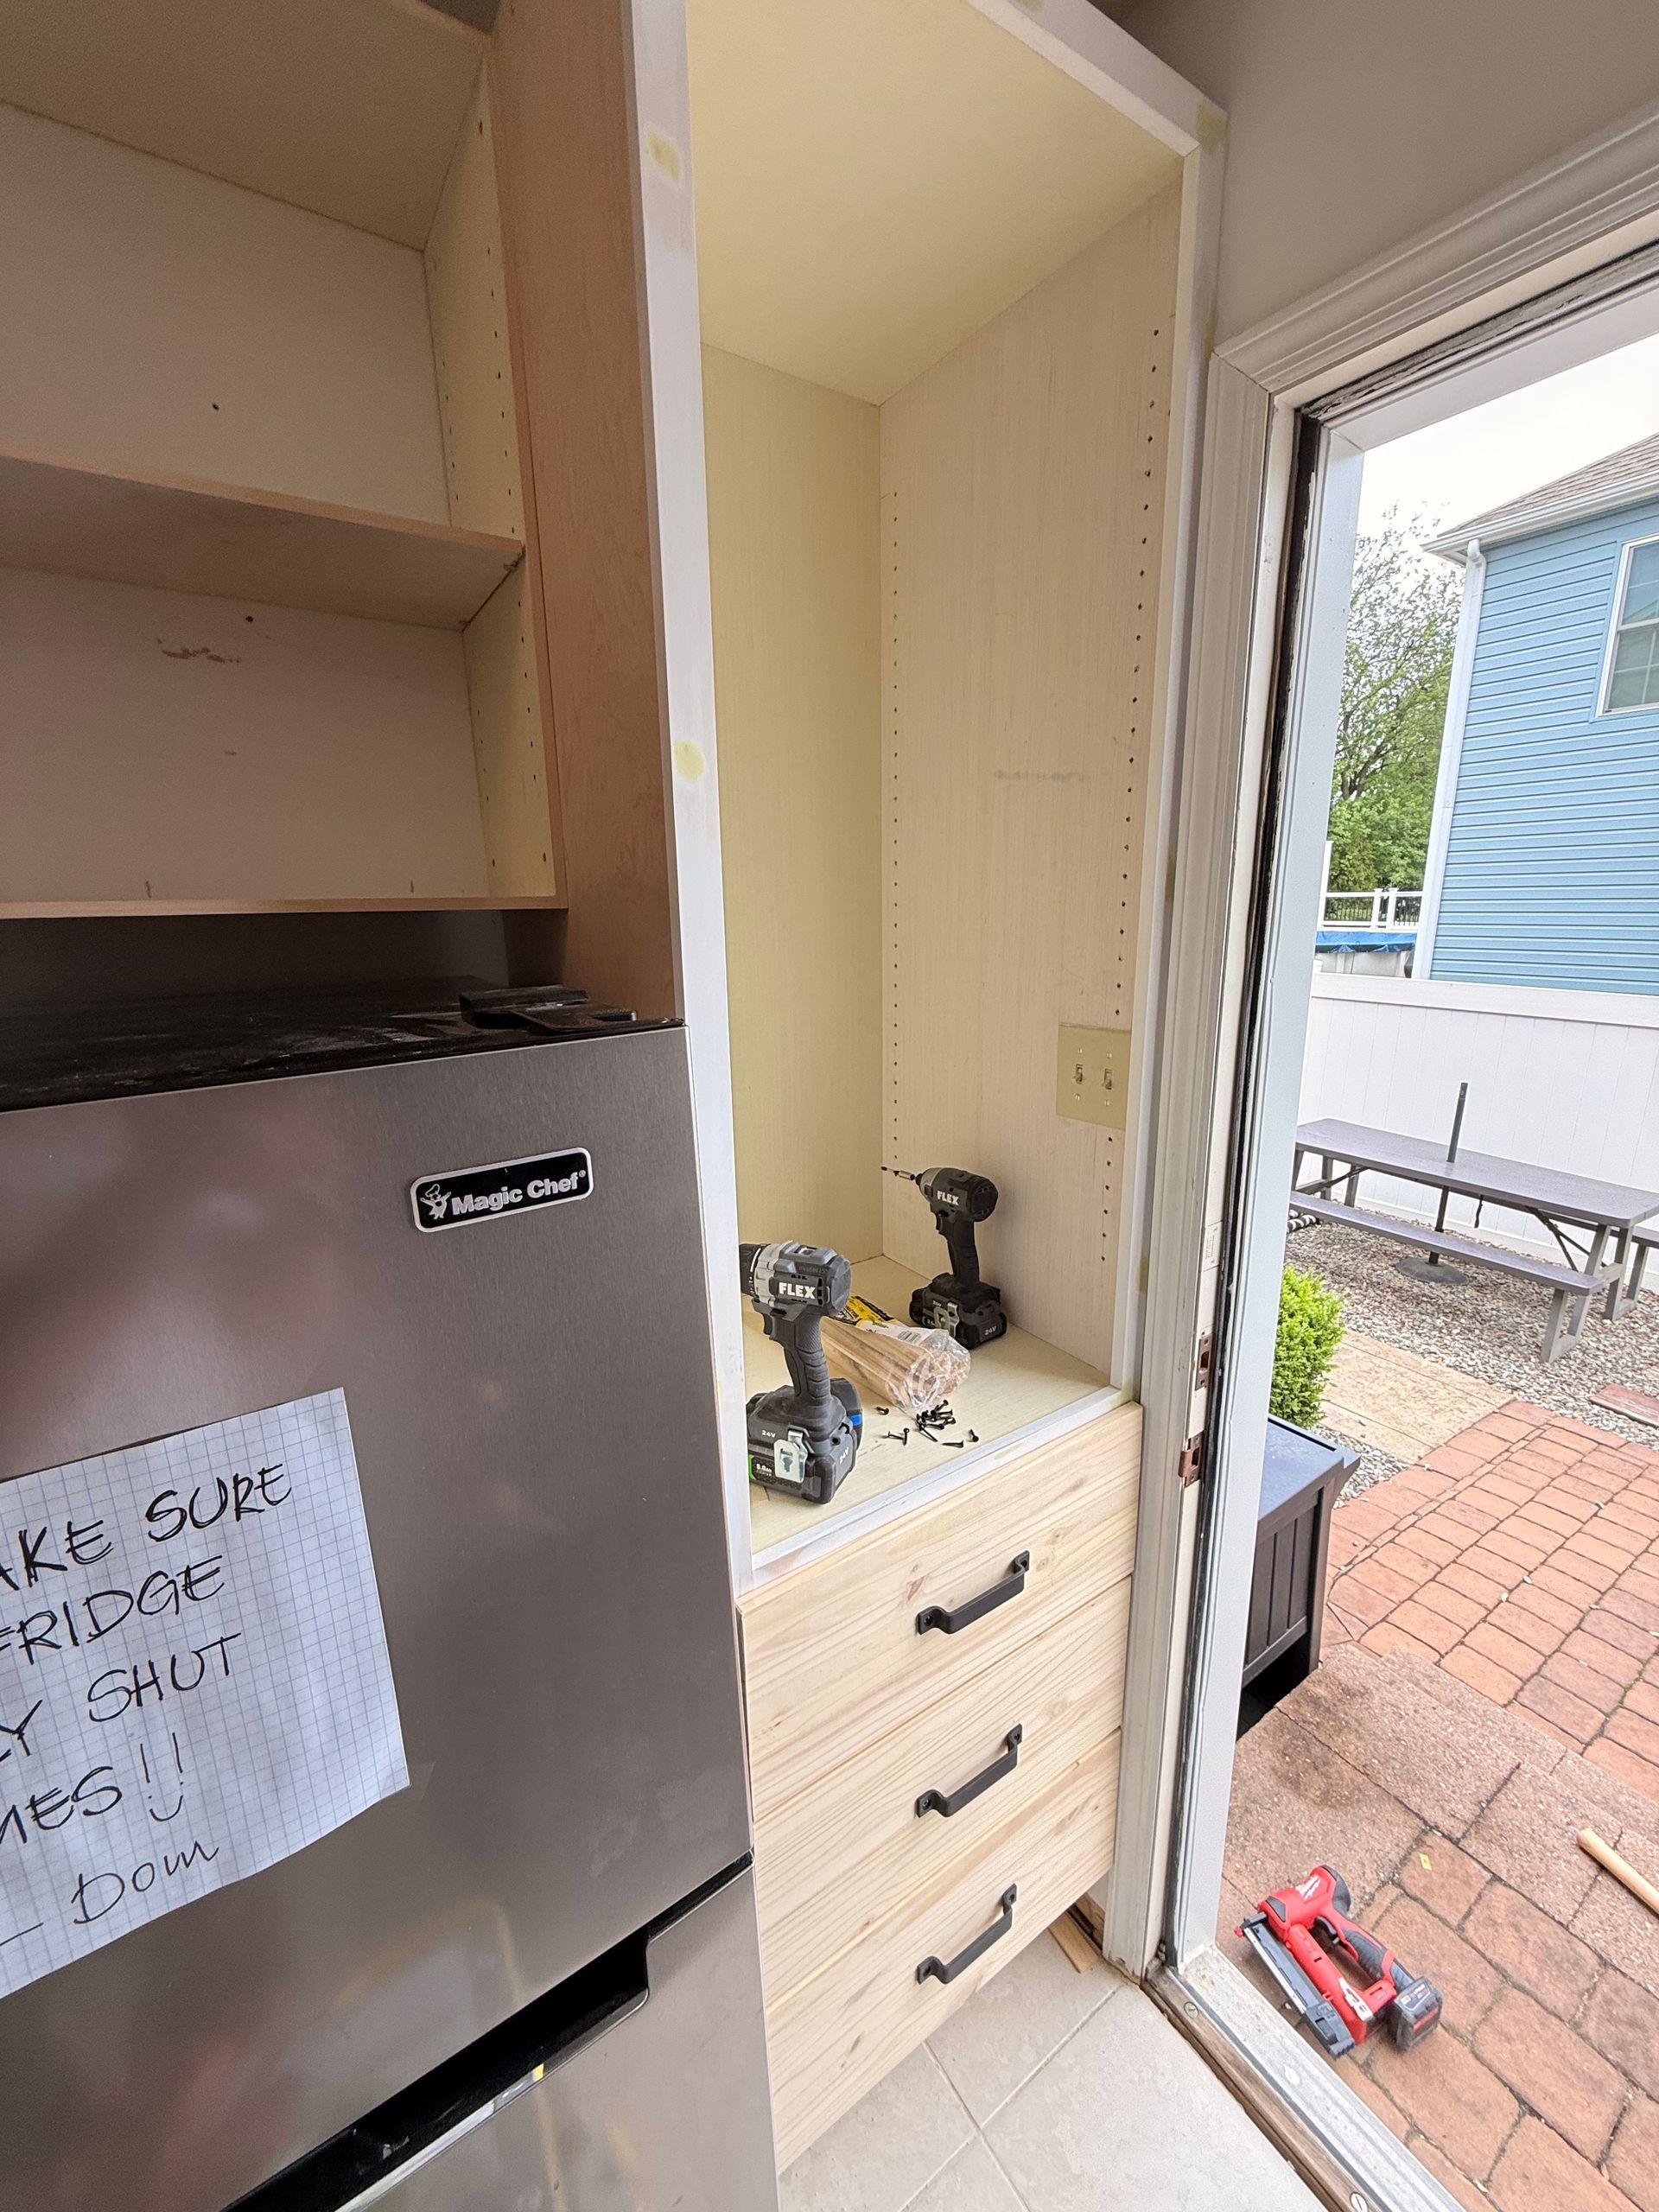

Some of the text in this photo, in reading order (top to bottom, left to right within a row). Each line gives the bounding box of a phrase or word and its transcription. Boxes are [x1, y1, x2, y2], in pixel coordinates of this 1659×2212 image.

[451, 1186, 523, 1215] Magic
[937, 1190, 959, 1206] FLEX
[779, 1281, 816, 1300] FLEX
[761, 1429, 776, 1438] 24V
[145, 1464, 292, 1542] SURE
[87, 1632, 242, 1723] SHUT
[71, 1840, 219, 1925] Dom
